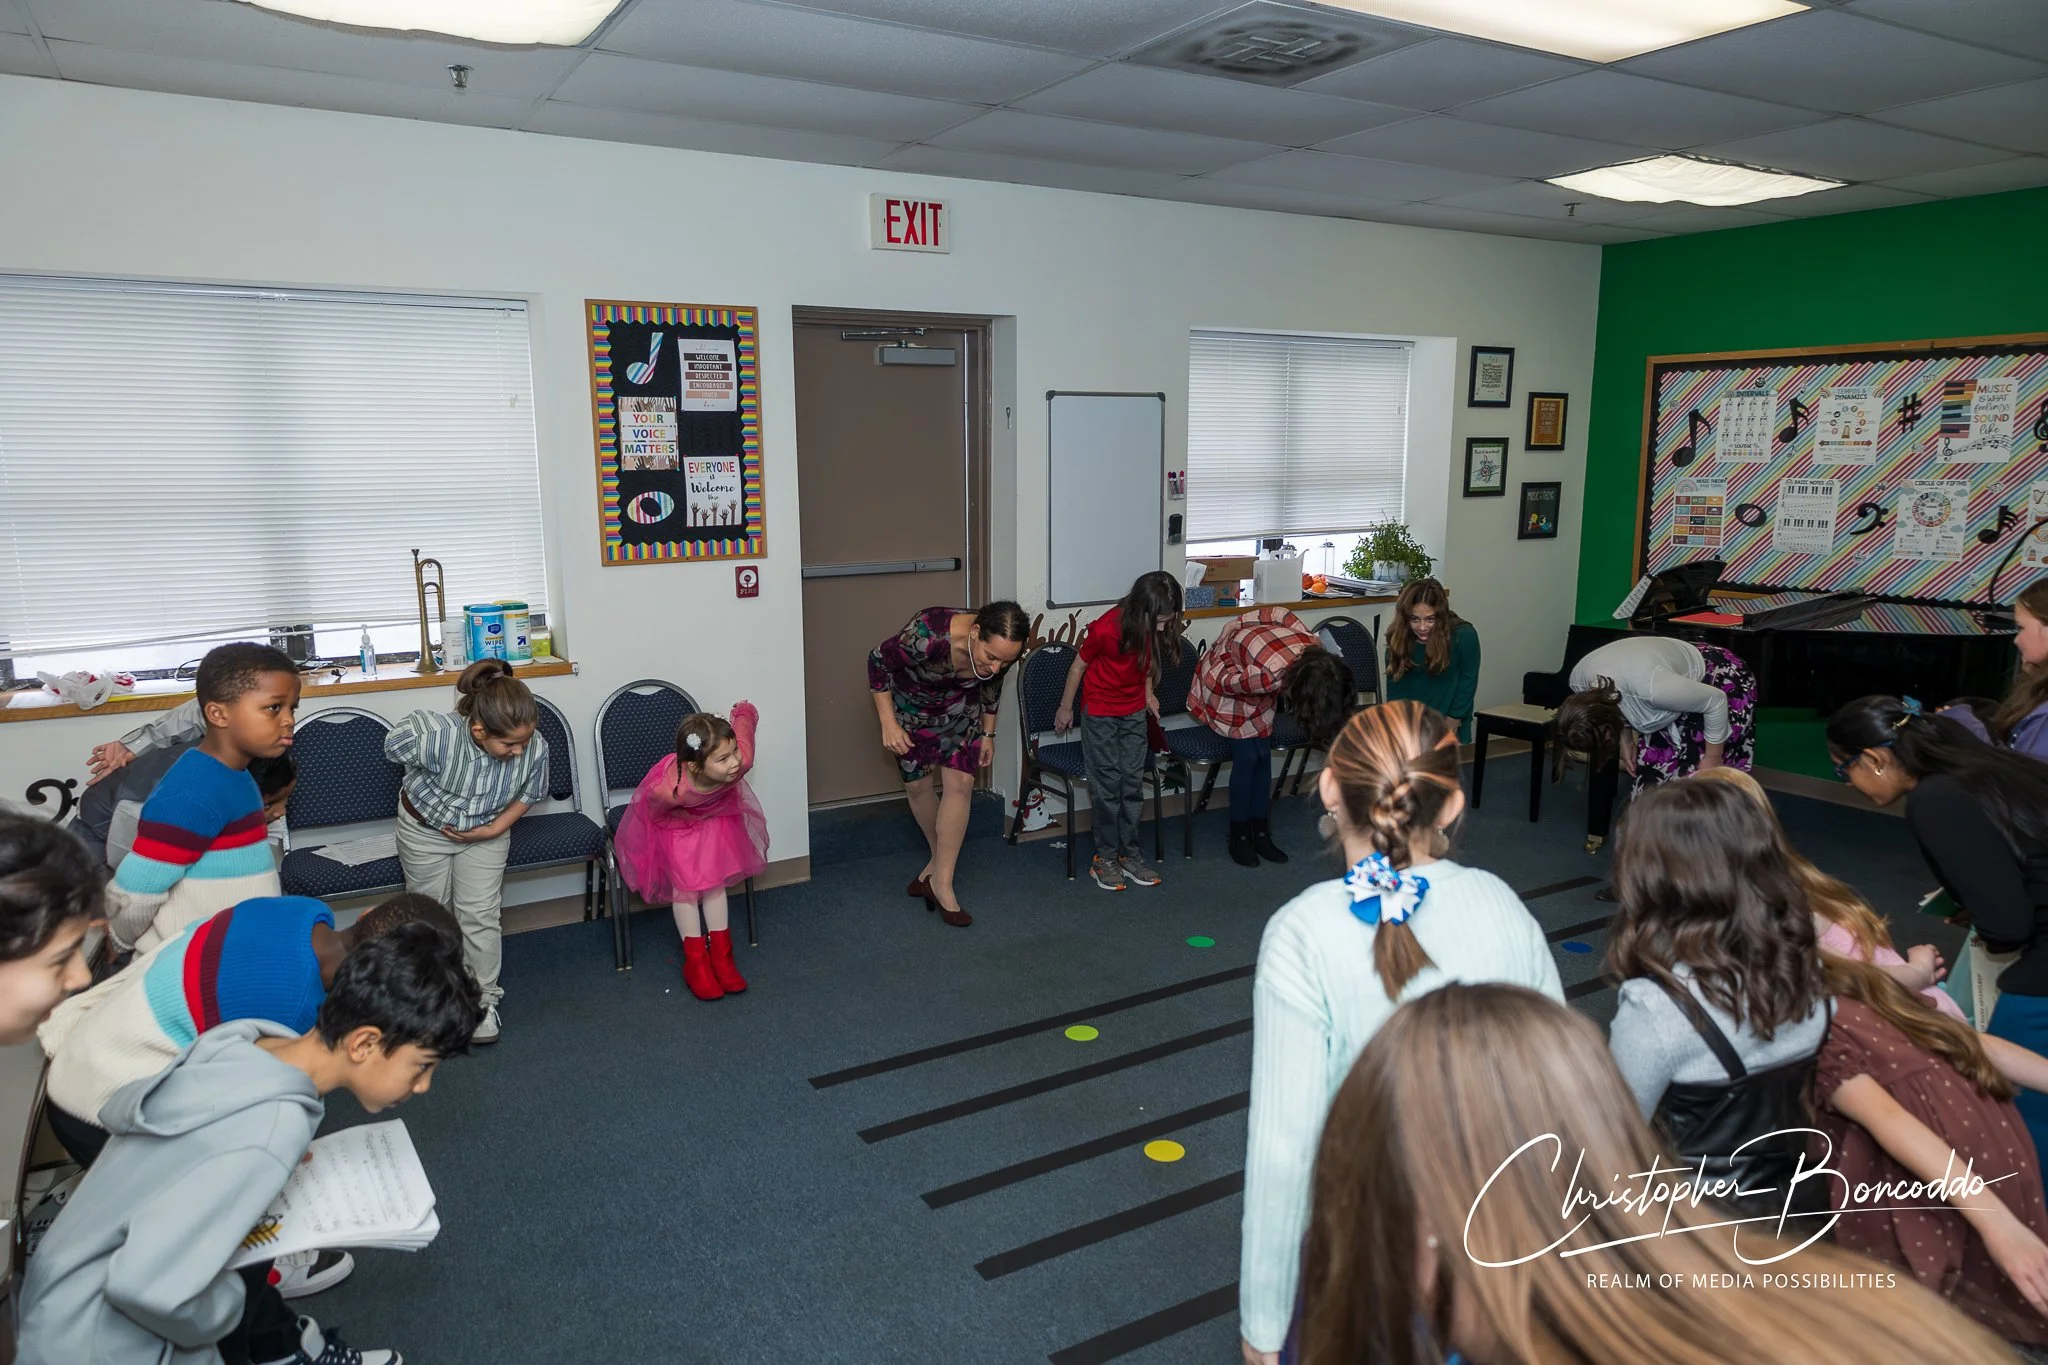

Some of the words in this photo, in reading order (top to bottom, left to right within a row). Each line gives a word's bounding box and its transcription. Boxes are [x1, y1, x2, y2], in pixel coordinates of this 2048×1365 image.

[886, 199, 942, 246] EXIT
[1977, 384, 2013, 394] MUSIC
[1987, 394, 2009, 402] WHAT
[1973, 403, 2010, 414] feelings
[633, 414, 664, 423] YOUR
[1973, 414, 2010, 423] SOUND
[633, 429, 666, 438] VOICE
[1979, 423, 2000, 435] like
[625, 444, 675, 454] MATTERS
[688, 461, 735, 473] EVERYONE
[691, 481, 735, 493] Welcome
